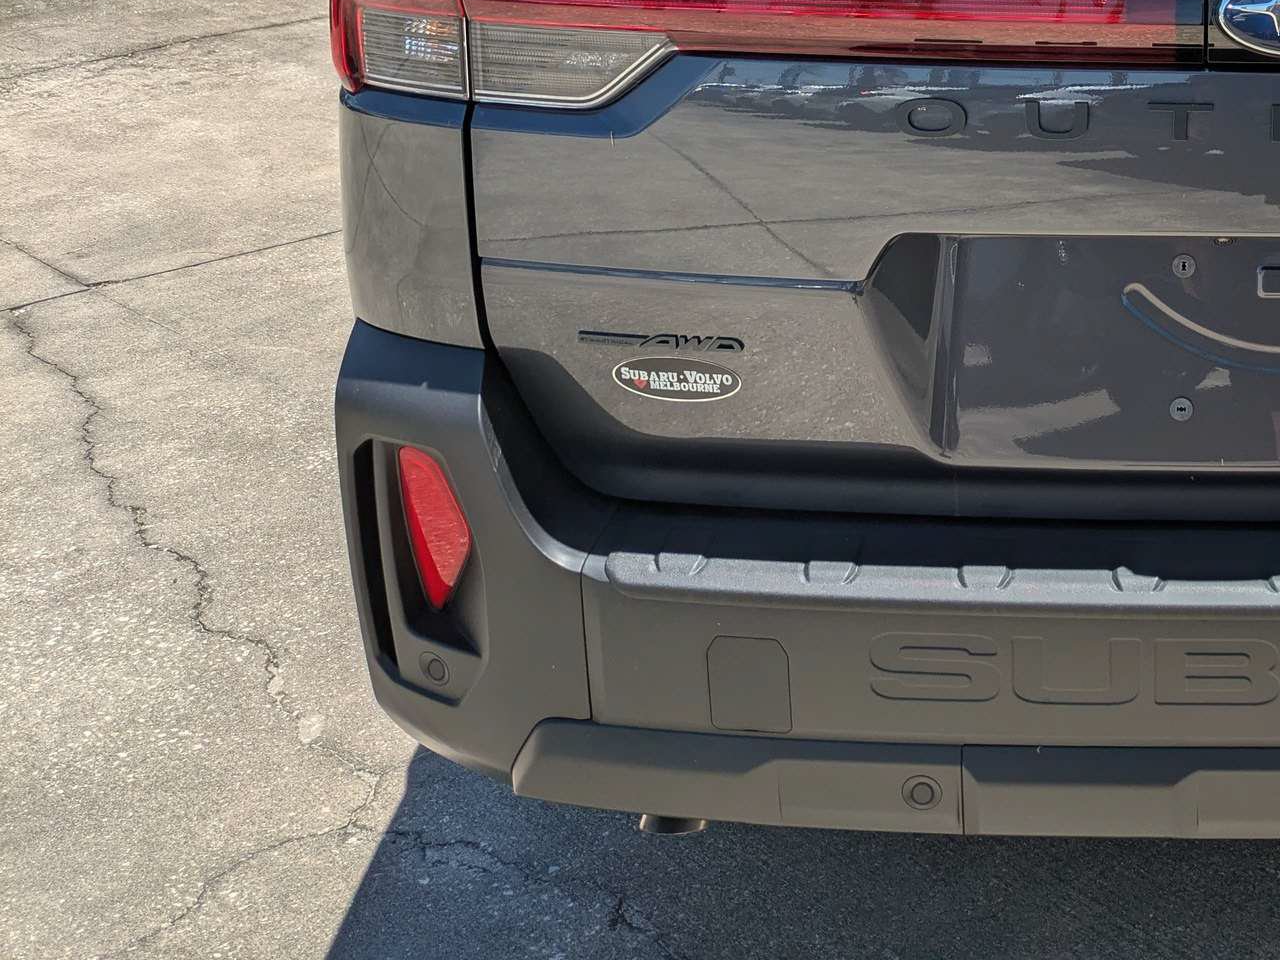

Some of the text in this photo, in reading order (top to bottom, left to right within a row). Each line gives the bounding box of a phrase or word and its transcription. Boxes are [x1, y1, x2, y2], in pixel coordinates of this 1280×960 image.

[639, 333, 746, 353] AWD
[620, 367, 733, 386] SUBARU VOLVO
[649, 381, 721, 393] MELBOURNE
